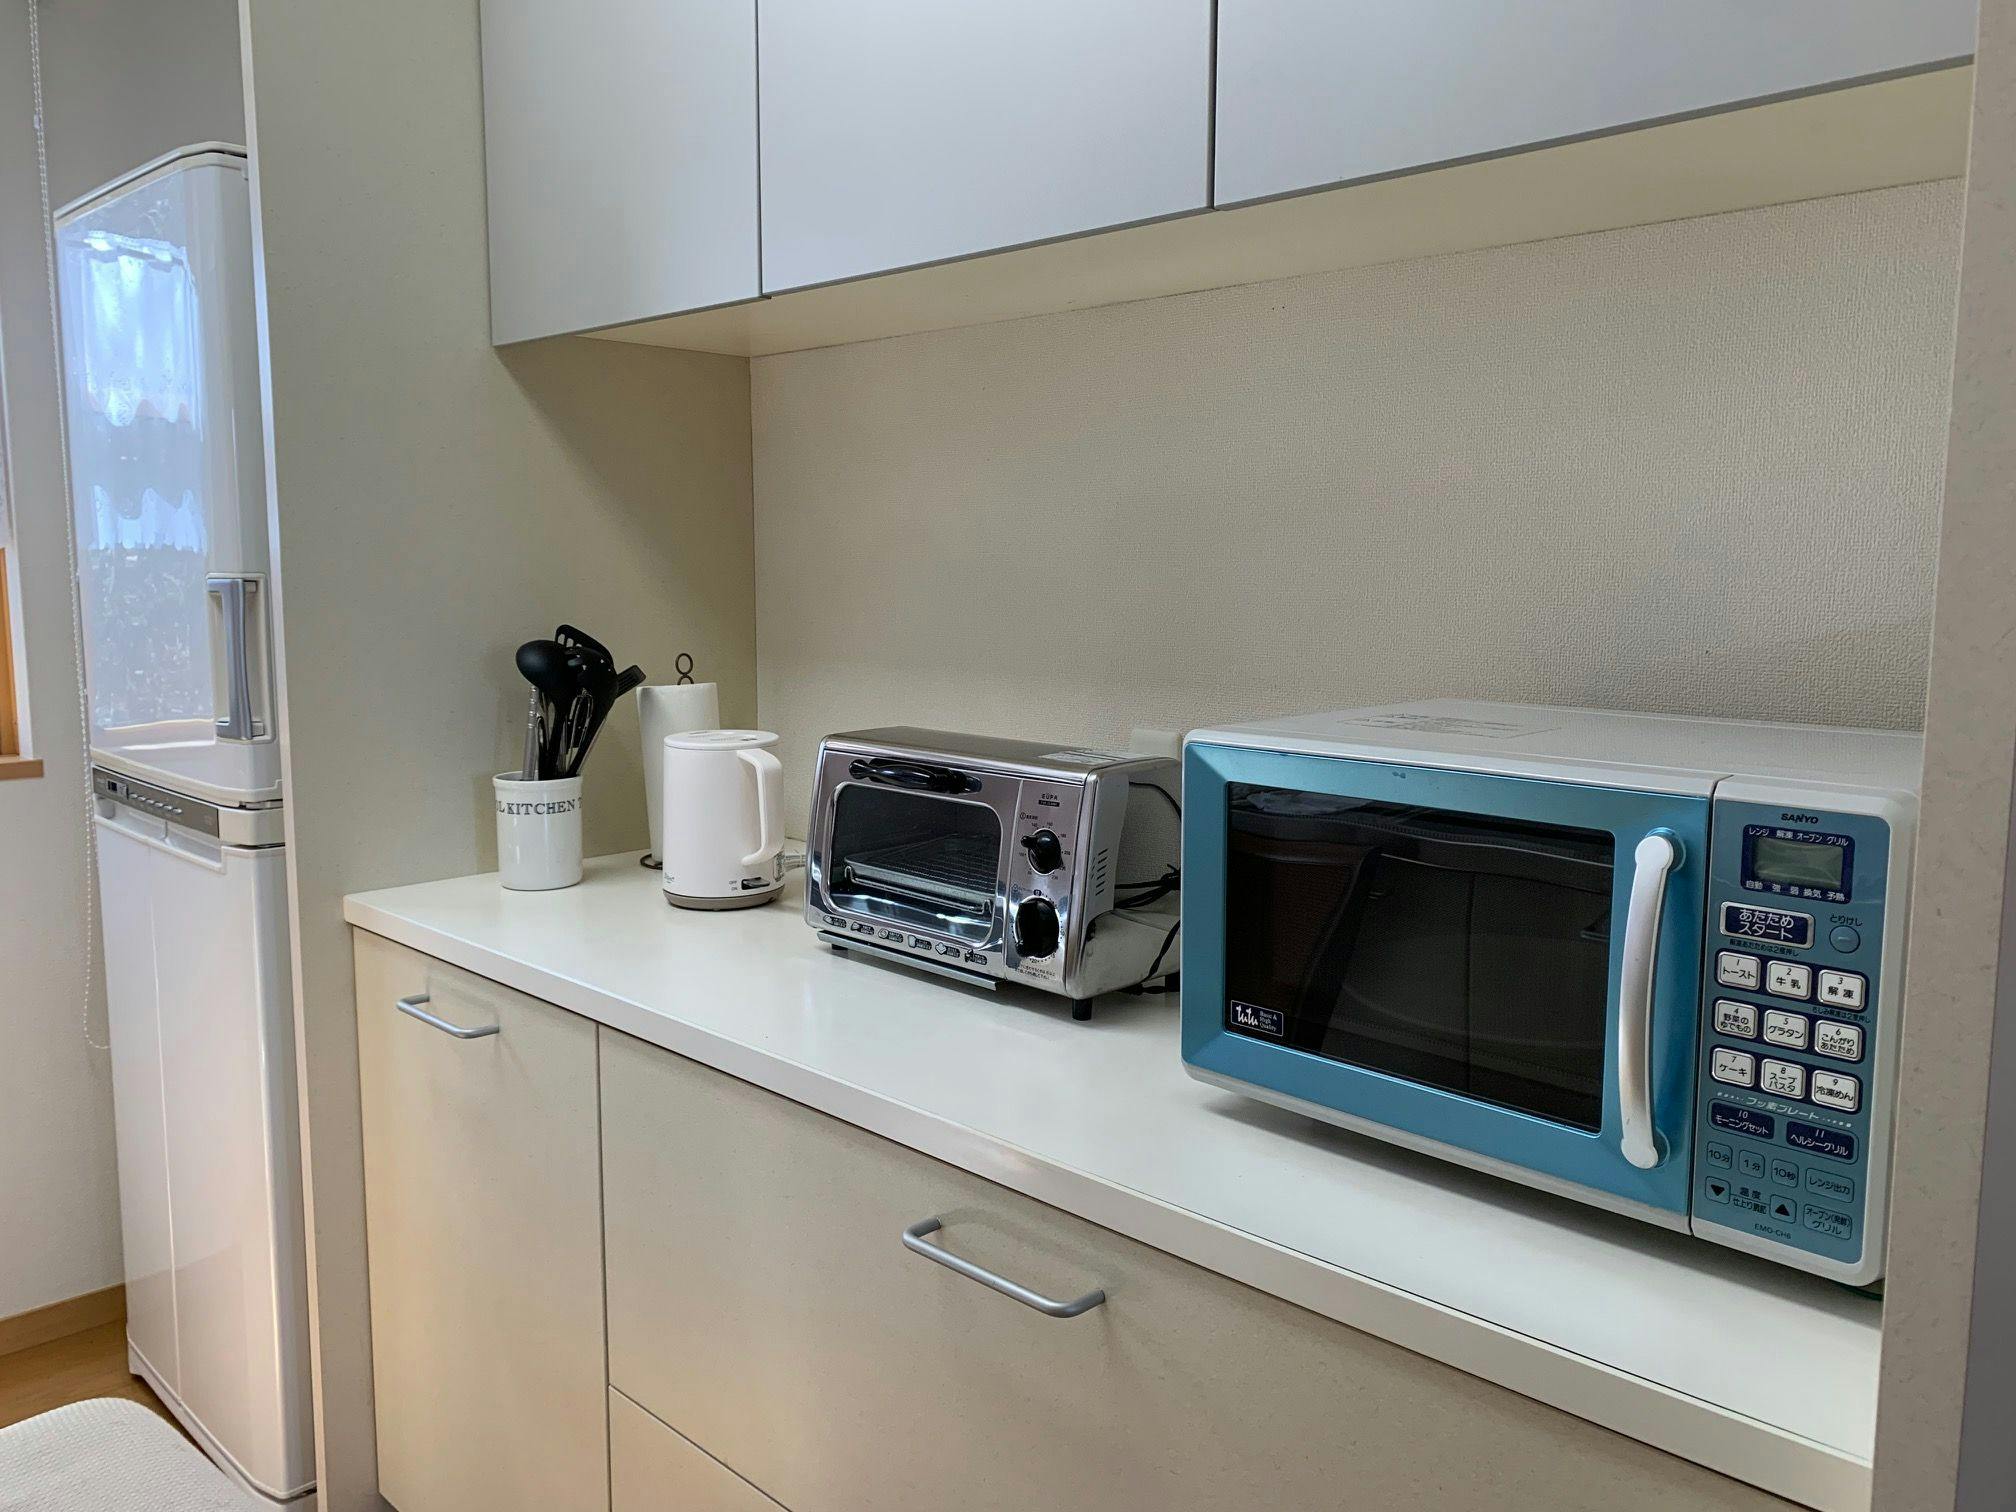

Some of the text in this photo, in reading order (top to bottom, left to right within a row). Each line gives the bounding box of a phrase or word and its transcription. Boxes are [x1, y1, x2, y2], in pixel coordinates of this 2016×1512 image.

[506, 799, 575, 815] KITCHEN
[1781, 813, 1819, 824] SANYO
[1749, 827, 1769, 836] レンジ
[1796, 832, 1822, 842] オーブン
[1826, 836, 1848, 846] グリル
[1739, 909, 1794, 928] あたため
[1830, 914, 1862, 926] とりけし
[1739, 922, 1793, 940] スタート
[1723, 966, 1756, 980] トースト
[1786, 968, 1792, 976] 2
[1260, 1022, 1276, 1032] Quality
[1720, 1021, 1751, 1034] ゆでもの
[1783, 1018, 1788, 1026] 5
[1768, 1025, 1804, 1038] グラタン
[1836, 1028, 1841, 1036] 6
[1821, 1033, 1855, 1046] こんがり
[1820, 1042, 1855, 1056] あたため
[1719, 1064, 1748, 1077] ケーキ
[1770, 1072, 1798, 1085] スープ
[1832, 1078, 1838, 1086] 9
[1768, 1080, 1796, 1092] パスタ
[1816, 1085, 1854, 1101] 冷凍めん
[1738, 1110, 1748, 1119] 10
[1746, 1096, 1819, 1120] フッ素プレート
[1715, 1114, 1769, 1135] モーニングセット
[1816, 1128, 1824, 1138] 11
[1790, 1134, 1848, 1156] ヘルシーグリル
[1709, 1150, 1730, 1163] 10分
[1809, 1177, 1850, 1195] レンジ出力
[1812, 1220, 1842, 1235] グリル
